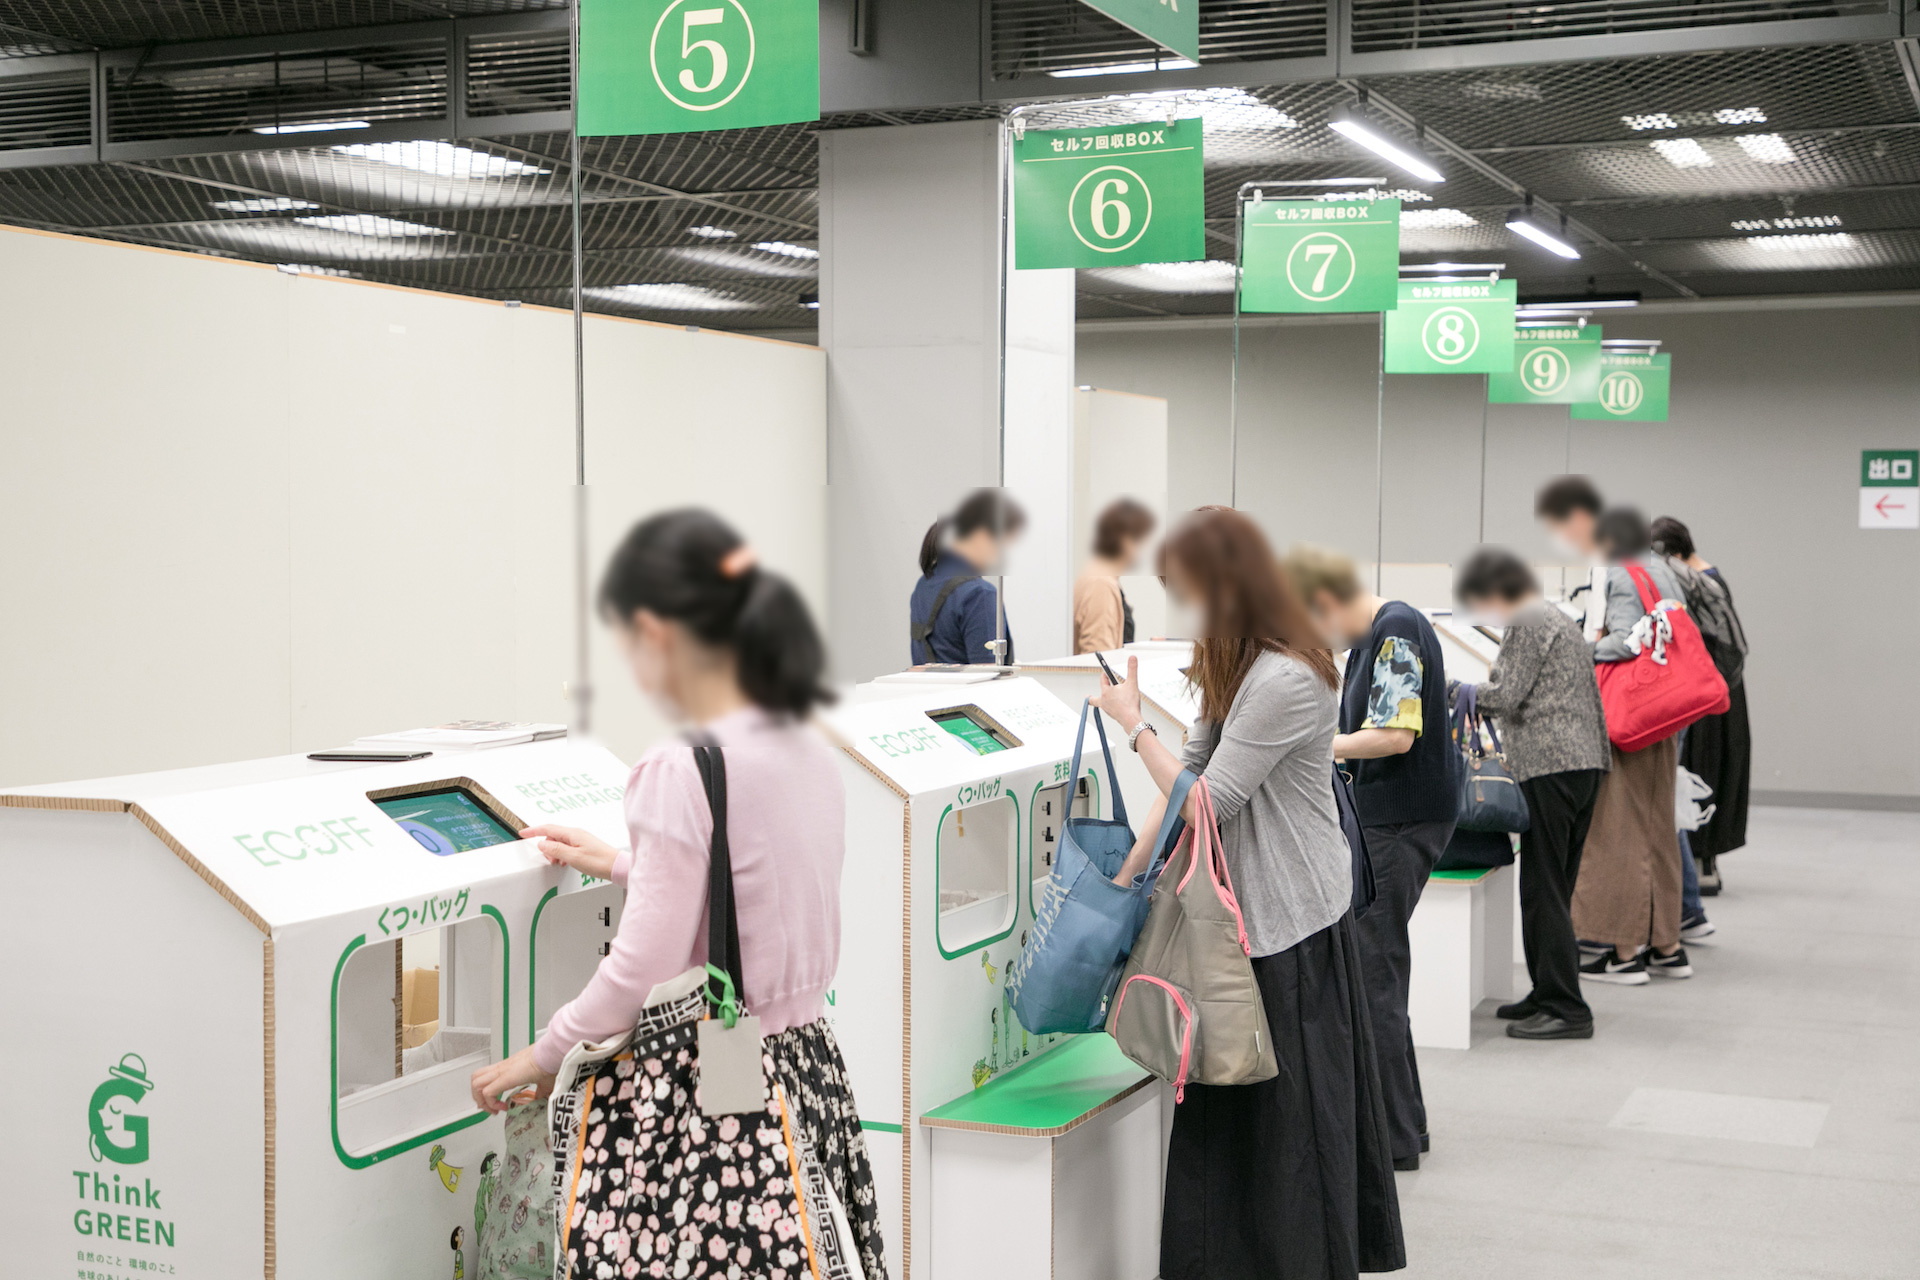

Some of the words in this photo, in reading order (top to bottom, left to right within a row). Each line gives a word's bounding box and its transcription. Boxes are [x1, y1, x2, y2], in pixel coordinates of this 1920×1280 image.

[678, 7, 729, 93] 5
[1050, 129, 1165, 152] セルフ回収BOX
[1090, 178, 1132, 240] 6
[1275, 206, 1369, 220] セルフ回収BOX
[1304, 244, 1338, 293] 7
[1411, 285, 1490, 298] セルフ回収BOX
[1436, 314, 1466, 357] 8
[1532, 353, 1559, 389] 9
[1607, 378, 1637, 409] 10
[1868, 457, 1913, 480] 出口
[514, 773, 600, 798] RECYCLE
[957, 776, 1002, 806] くつ・バッグ
[378, 887, 472, 936] くつ・バッグ
[72, 1170, 162, 1210] Think
[74, 1209, 175, 1248] GREEN
[77, 1250, 122, 1267] 自然のこと
[129, 1258, 175, 1275] 環境のこと
[78, 1269, 142, 1280] 地球のあし
